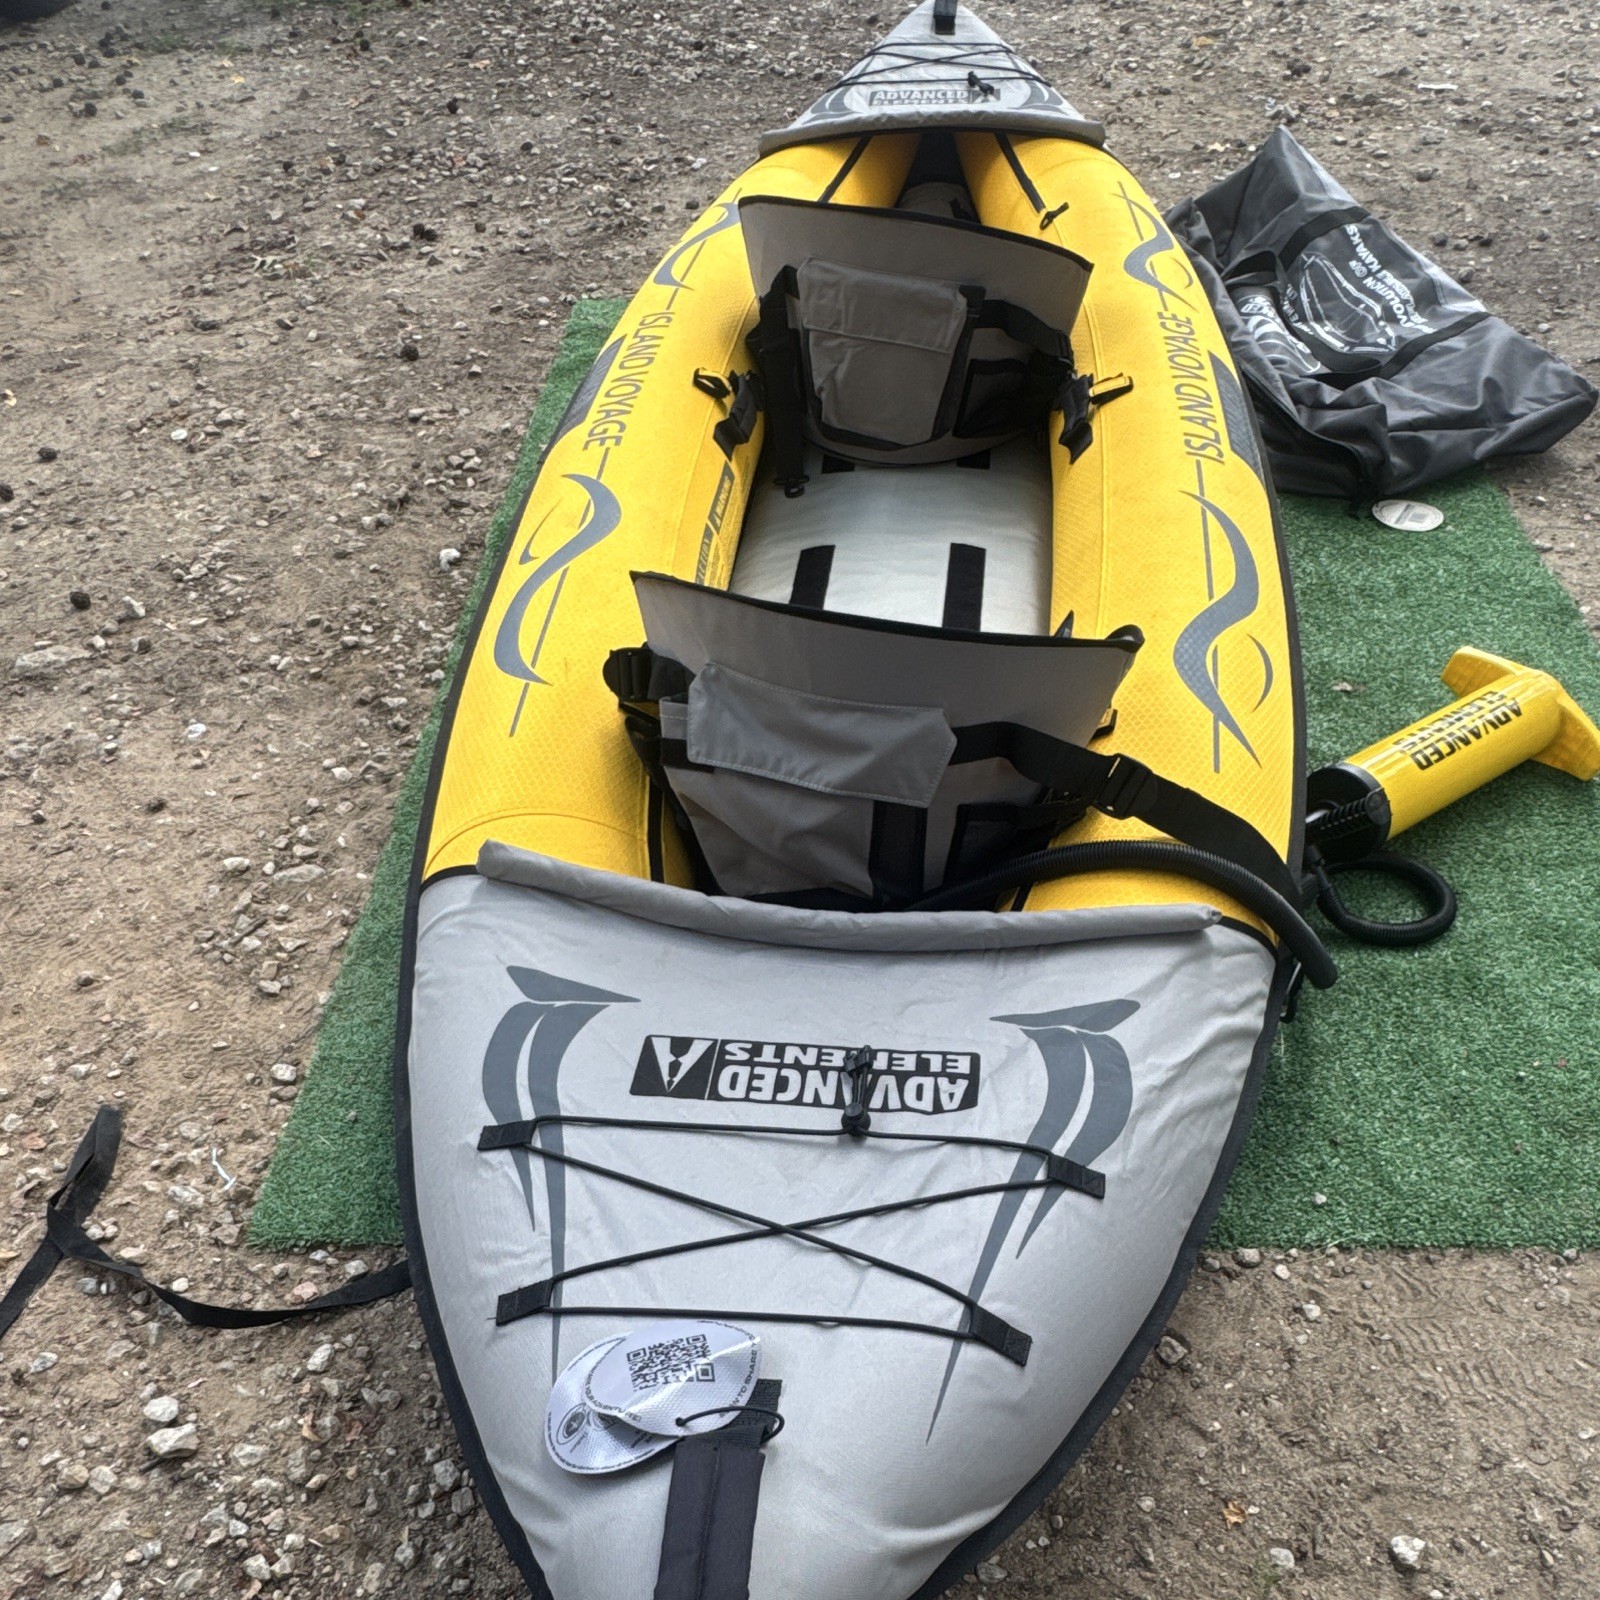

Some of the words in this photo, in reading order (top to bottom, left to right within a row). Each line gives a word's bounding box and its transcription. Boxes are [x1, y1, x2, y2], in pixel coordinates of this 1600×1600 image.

[874, 90, 969, 100] ADVANCED
[1344, 224, 1382, 273] KAYAKS
[618, 312, 676, 370] ISLAND
[1157, 311, 1208, 382] VOYAGE
[582, 371, 649, 451] VOYAGE
[1174, 383, 1226, 466] ISLAND
[1410, 697, 1523, 771] ADVANCED
[744, 1349, 758, 1386] SHARE
